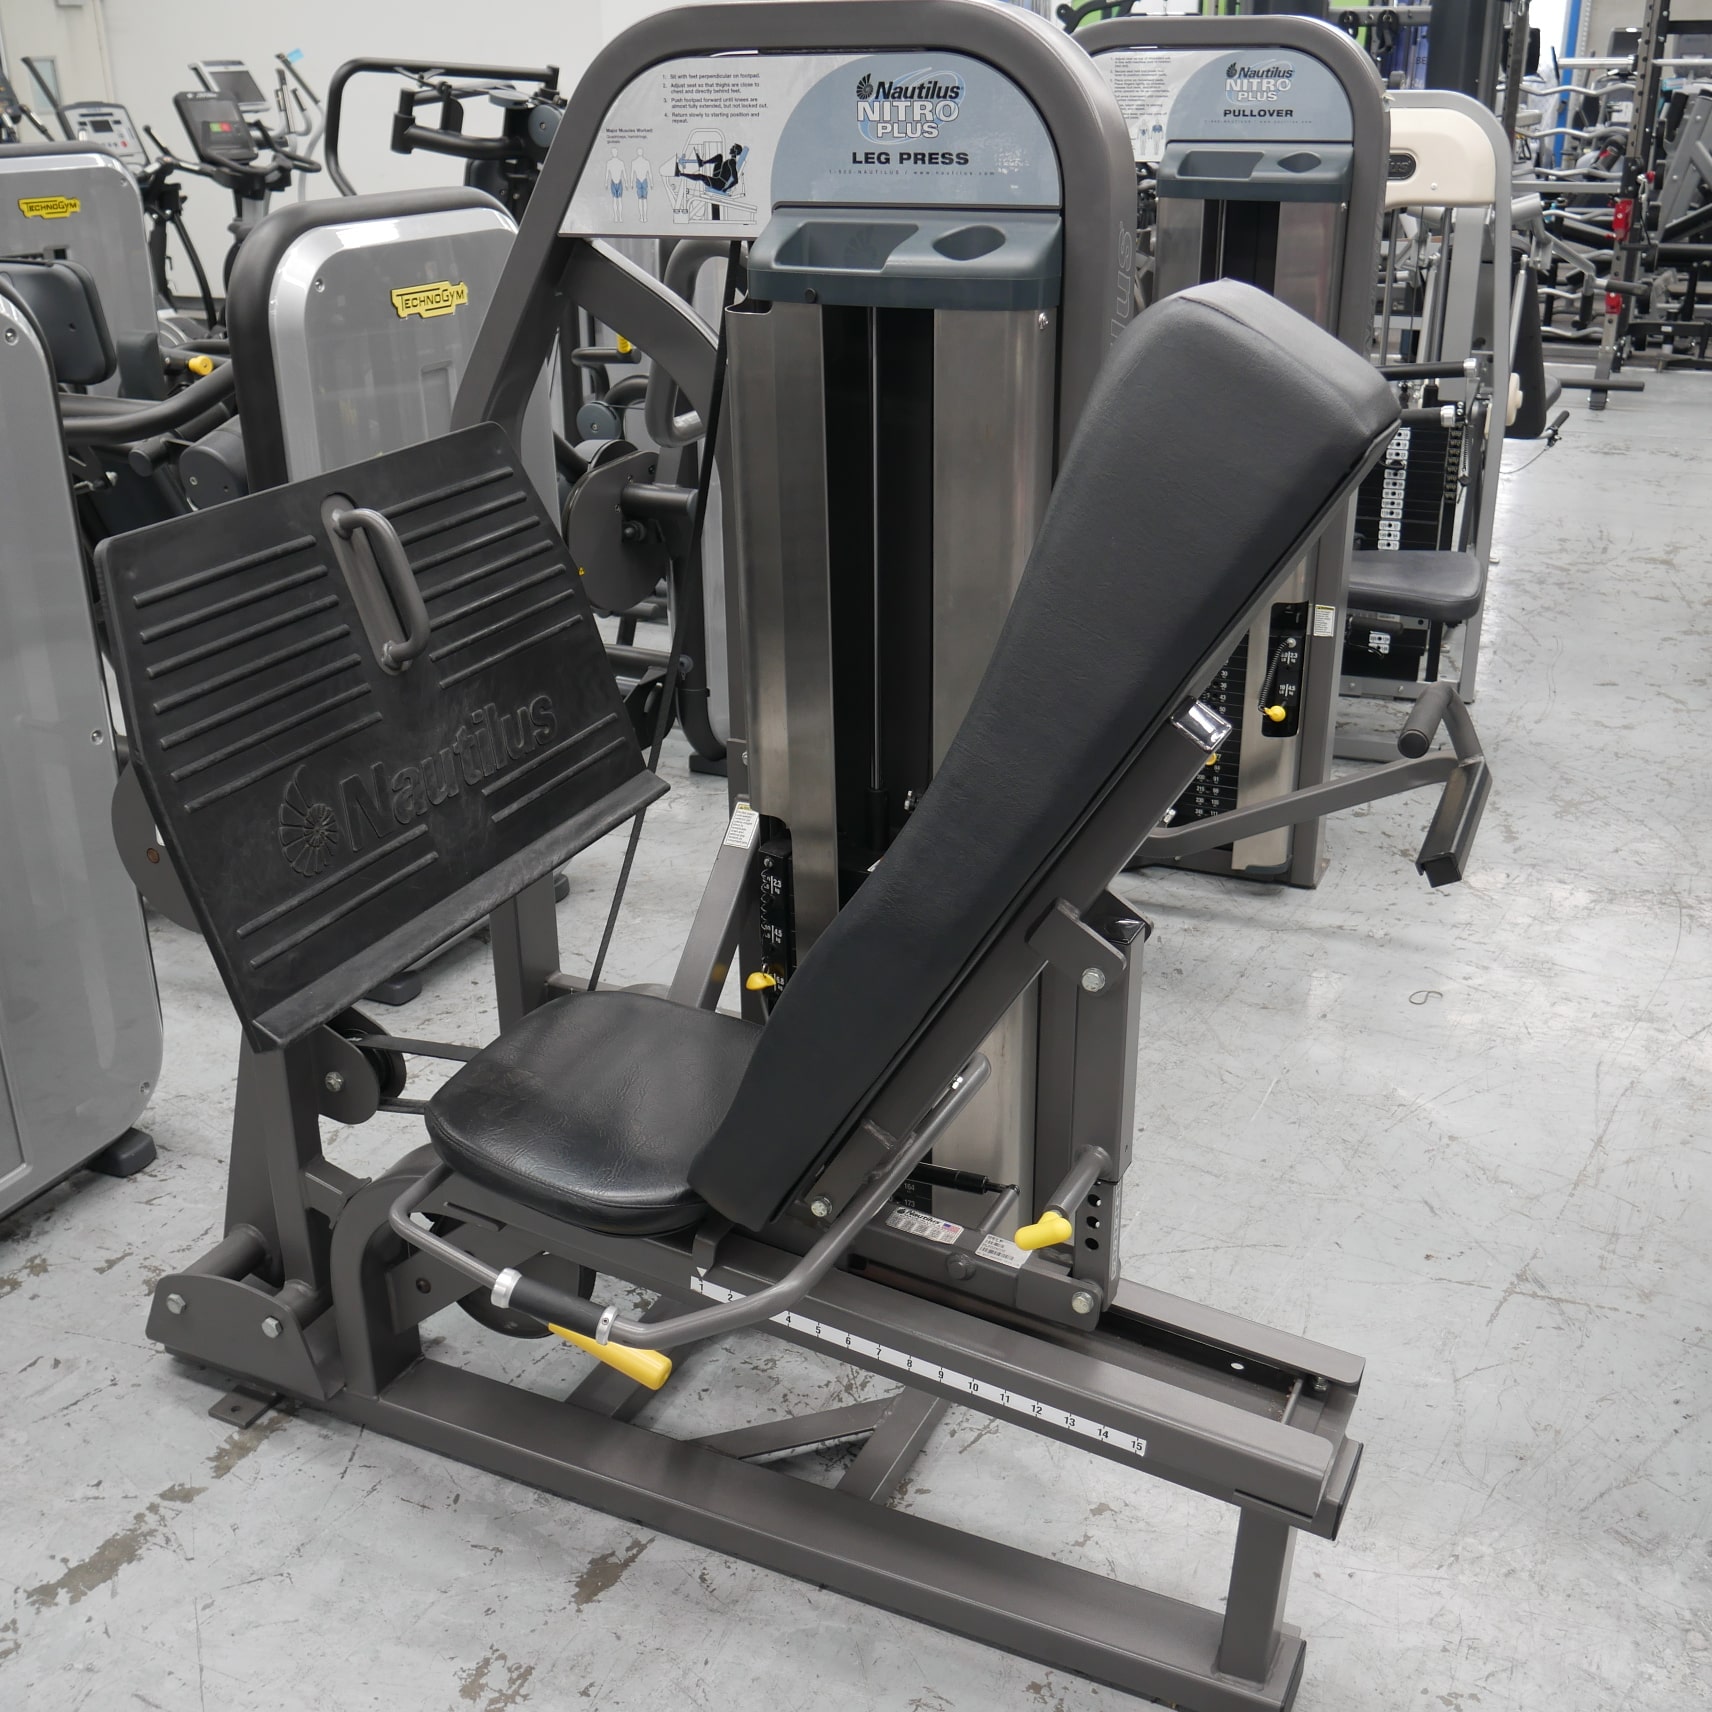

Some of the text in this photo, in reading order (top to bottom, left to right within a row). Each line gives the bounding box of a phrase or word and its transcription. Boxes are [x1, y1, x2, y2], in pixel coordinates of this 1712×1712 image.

[1238, 66, 1293, 78] Nautilus
[874, 81, 961, 100] Nautilus
[1225, 78, 1291, 91] NITRO
[1238, 91, 1278, 101] PLUS
[856, 100, 960, 122] NITRO
[1223, 109, 1294, 118] PULLOVER
[877, 122, 939, 138] PLUS
[851, 152, 969, 165] LEG PRESS
[396, 287, 465, 312] TECHNOGYM
[339, 695, 556, 852] Nautilus
[904, 1199, 916, 1208] 173
[905, 1209, 941, 1225] Nautilus
[727, 1293, 733, 1301] 2
[785, 1315, 792, 1324] 4
[815, 1326, 821, 1334] 5
[846, 1337, 851, 1345] 6
[876, 1348, 882, 1356] 7
[907, 1359, 913, 1368] 8
[938, 1370, 944, 1379] 9
[967, 1381, 979, 1392] 10
[999, 1393, 1010, 1404] 11
[1031, 1404, 1042, 1415] 12
[1063, 1416, 1075, 1427] 13
[1097, 1428, 1109, 1439] 14
[1131, 1440, 1143, 1451] 15
